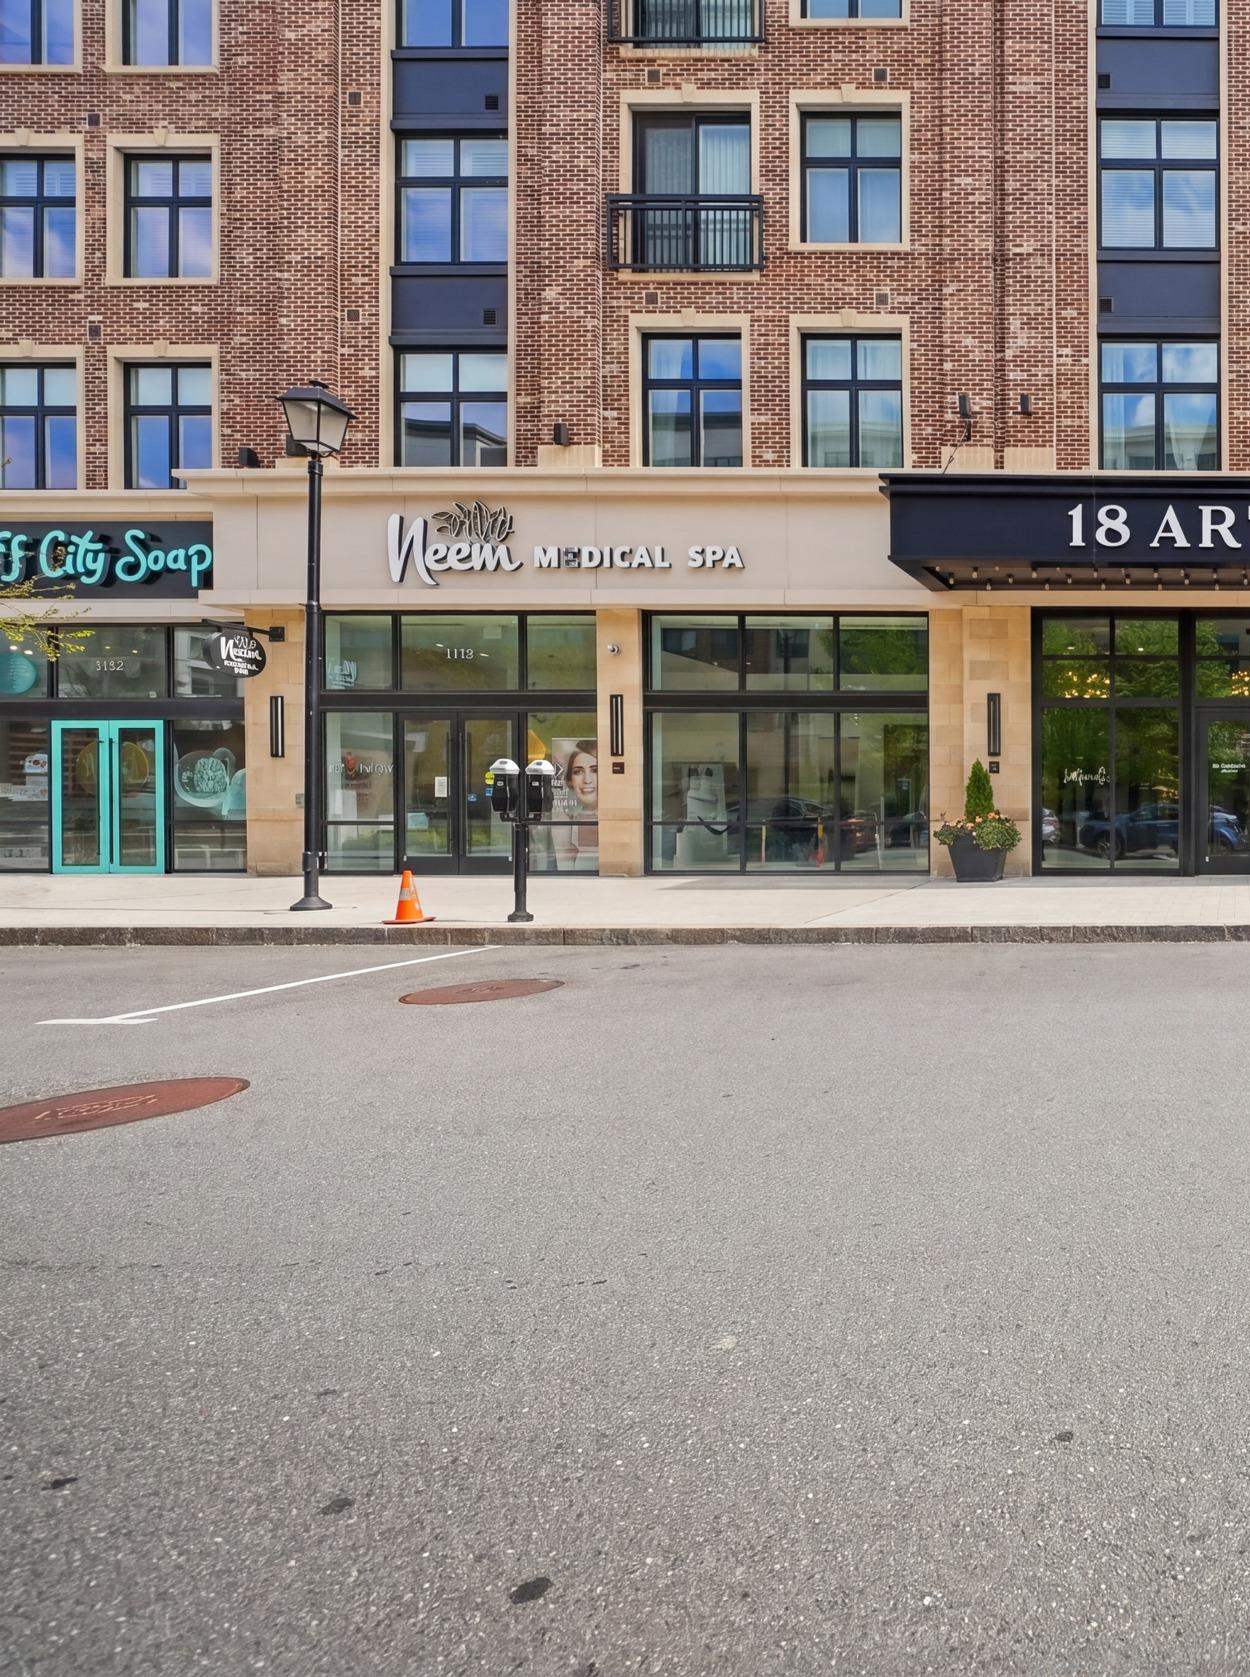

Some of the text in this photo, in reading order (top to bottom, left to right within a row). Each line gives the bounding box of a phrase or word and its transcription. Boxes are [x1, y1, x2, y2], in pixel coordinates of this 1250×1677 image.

[387, 513, 744, 585] Neem MEDICAL SPA
[1067, 503, 1131, 547] 18
[39, 530, 104, 585] City
[115, 529, 212, 587] Soap
